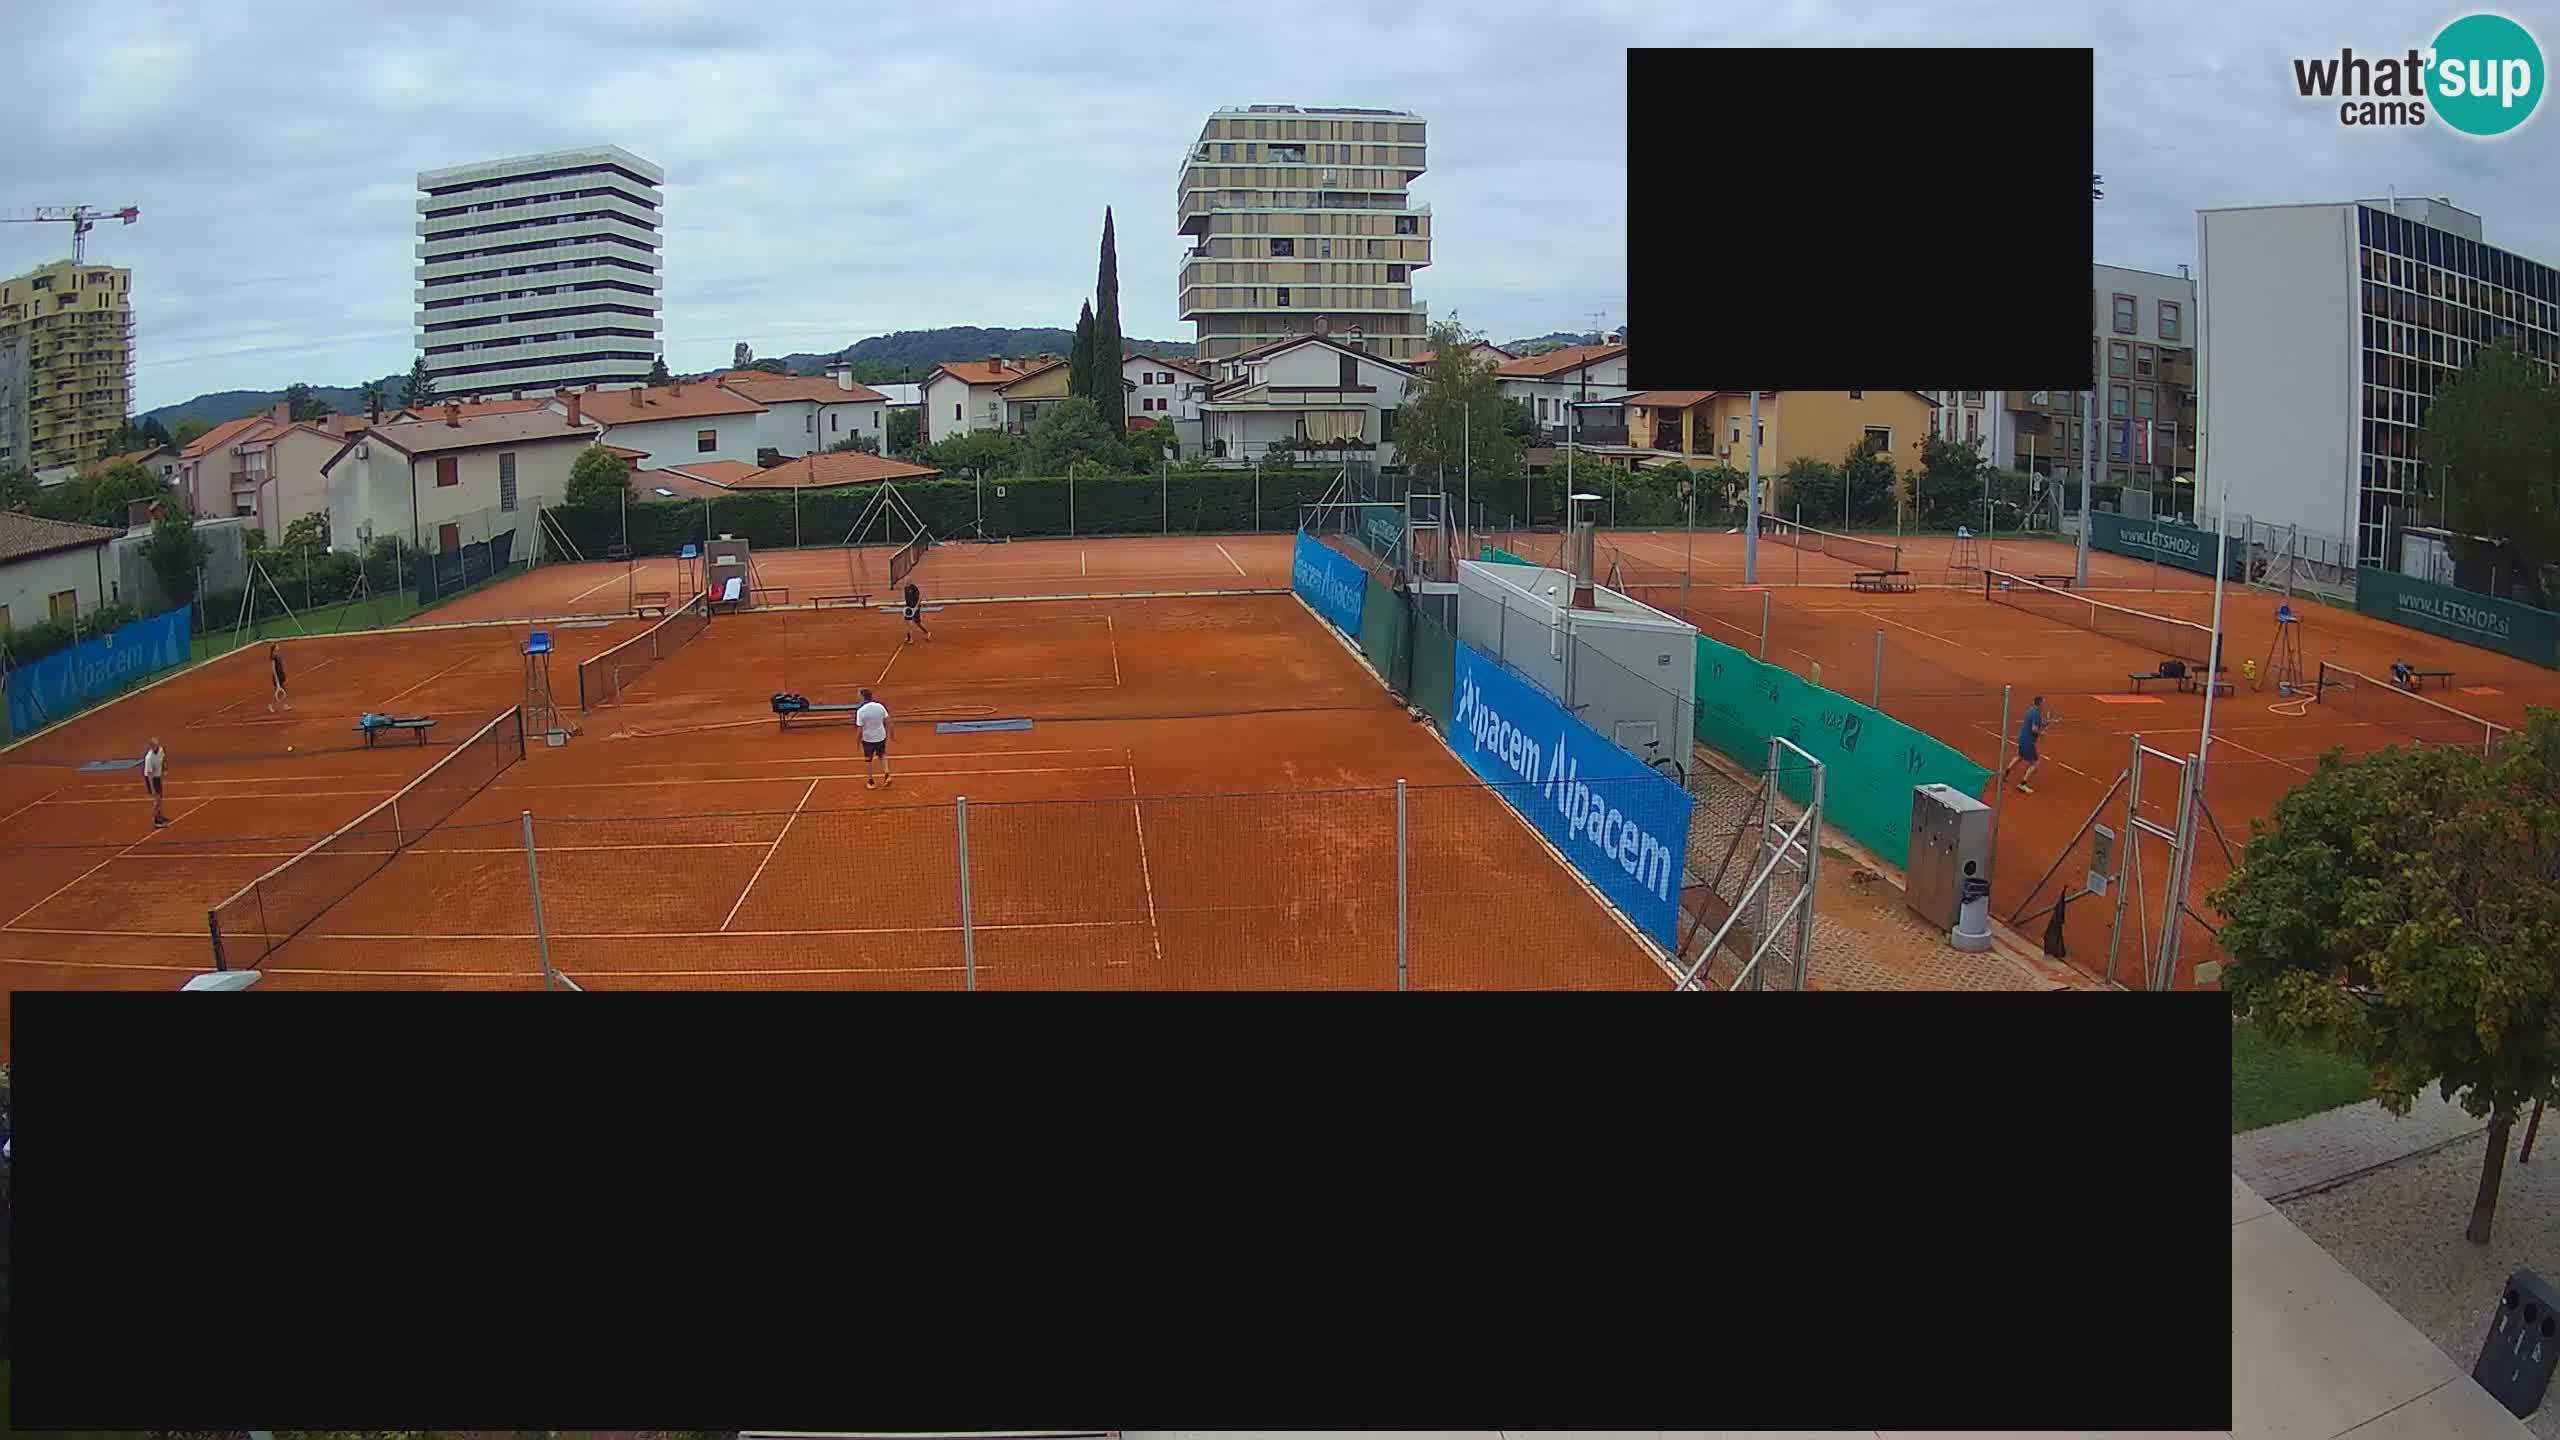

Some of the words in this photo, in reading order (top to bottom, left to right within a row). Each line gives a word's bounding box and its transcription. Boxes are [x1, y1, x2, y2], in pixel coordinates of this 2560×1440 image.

[2398, 593, 2511, 635] www.LETSHOP.si
[1456, 667, 1541, 786] Alpacem
[1545, 730, 1672, 903] Alpacem
